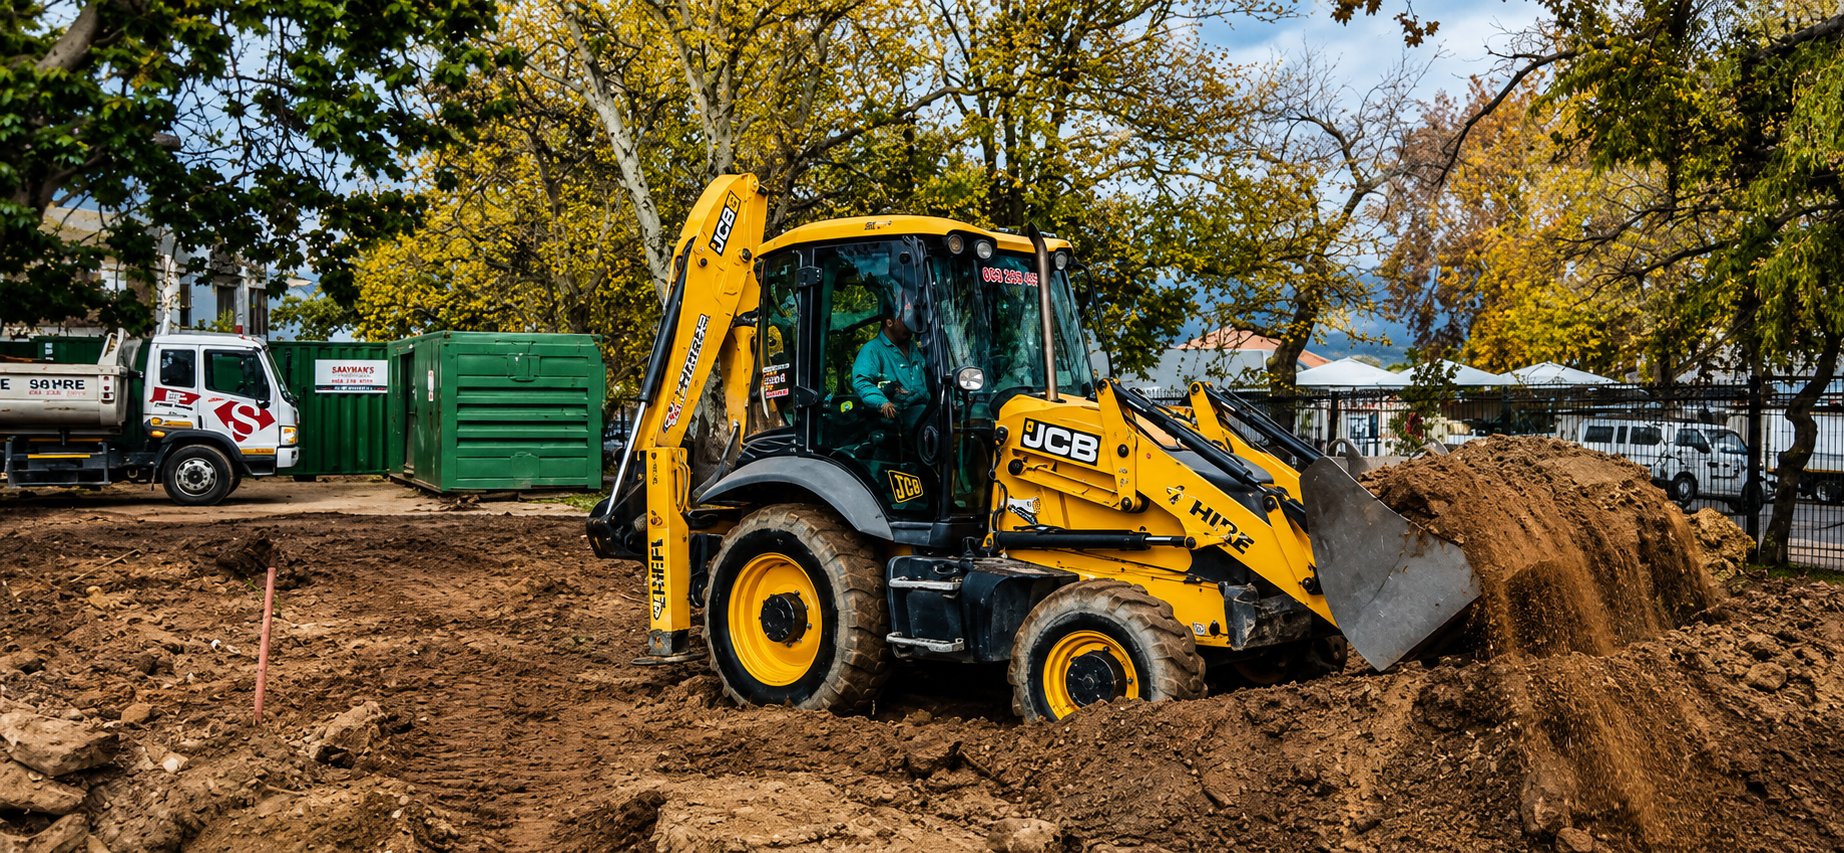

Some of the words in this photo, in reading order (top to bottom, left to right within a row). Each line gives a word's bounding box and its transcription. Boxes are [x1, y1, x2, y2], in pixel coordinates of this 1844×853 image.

[713, 206, 736, 254] JCB
[1022, 423, 1098, 463] JCB
[894, 474, 921, 500] JCB
